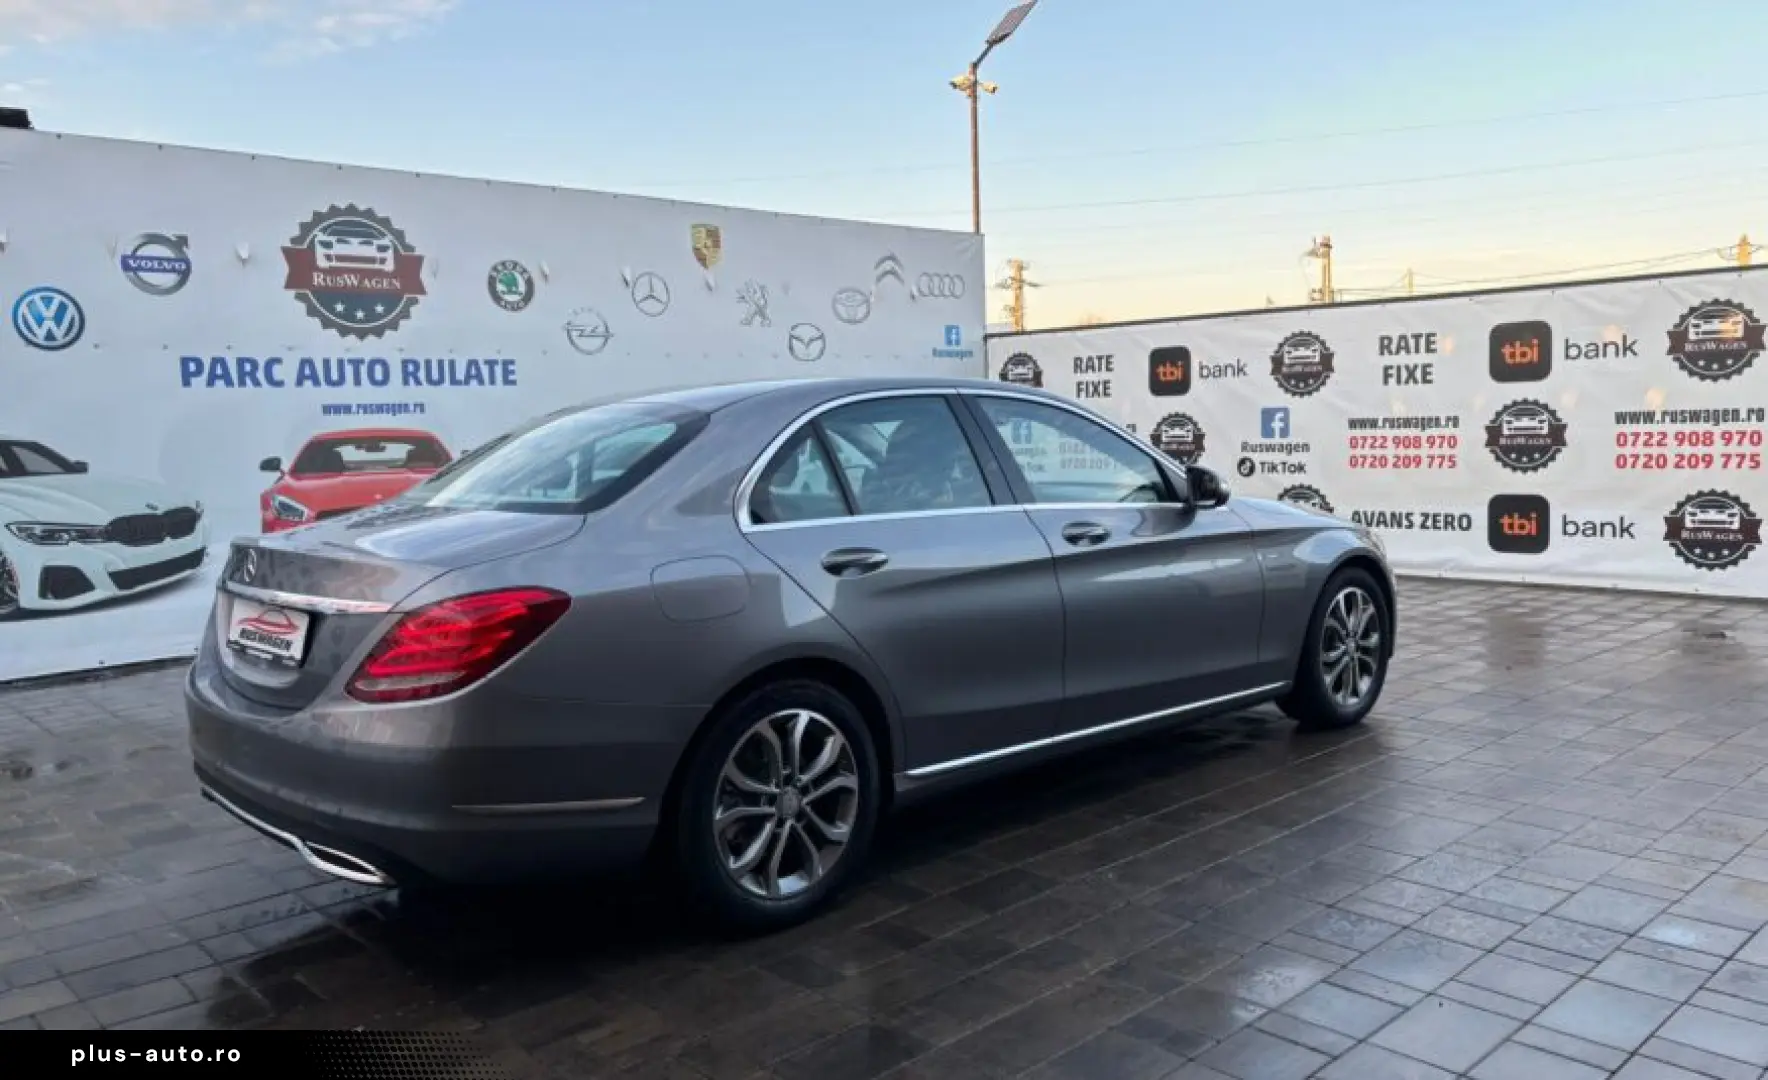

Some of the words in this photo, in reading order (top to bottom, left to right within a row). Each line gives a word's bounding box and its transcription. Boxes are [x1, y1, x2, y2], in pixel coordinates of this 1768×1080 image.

[127, 257, 187, 272] VOLVO
[1378, 331, 1438, 356] RATE
[1502, 338, 1540, 365] tbi
[1563, 333, 1638, 361] bank
[180, 356, 285, 388] PARC
[296, 357, 391, 387] AUTO
[402, 358, 517, 387] RULATE
[1073, 355, 1115, 375] RATE
[1156, 360, 1184, 382] tbi
[1199, 359, 1248, 379] bank
[1382, 363, 1434, 386] FIXE
[1075, 379, 1112, 399] FIXE
[322, 402, 425, 417] www.ruswagen.ro
[1614, 407, 1765, 425] www.ruswagen.ro
[1347, 414, 1460, 432] www.ruswagen.ro
[1348, 435, 1388, 450] 0722
[1392, 435, 1422, 450] 908
[1426, 435, 1458, 450] 970
[1615, 430, 1668, 448] 0722
[1674, 430, 1715, 448] 908
[1720, 430, 1763, 448] 970
[1241, 441, 1310, 456] Ruswagen
[1259, 460, 1307, 475] TikTok
[1348, 454, 1388, 469] 0720
[1392, 454, 1422, 469] 209
[1426, 454, 1457, 469] 775
[1615, 453, 1668, 470] 0720
[1674, 453, 1715, 470] 209
[1720, 453, 1762, 470] 775
[1351, 509, 1414, 530] AVANS
[1419, 511, 1473, 532] ZERO
[1500, 510, 1538, 537] tbi
[1561, 514, 1636, 540] bank
